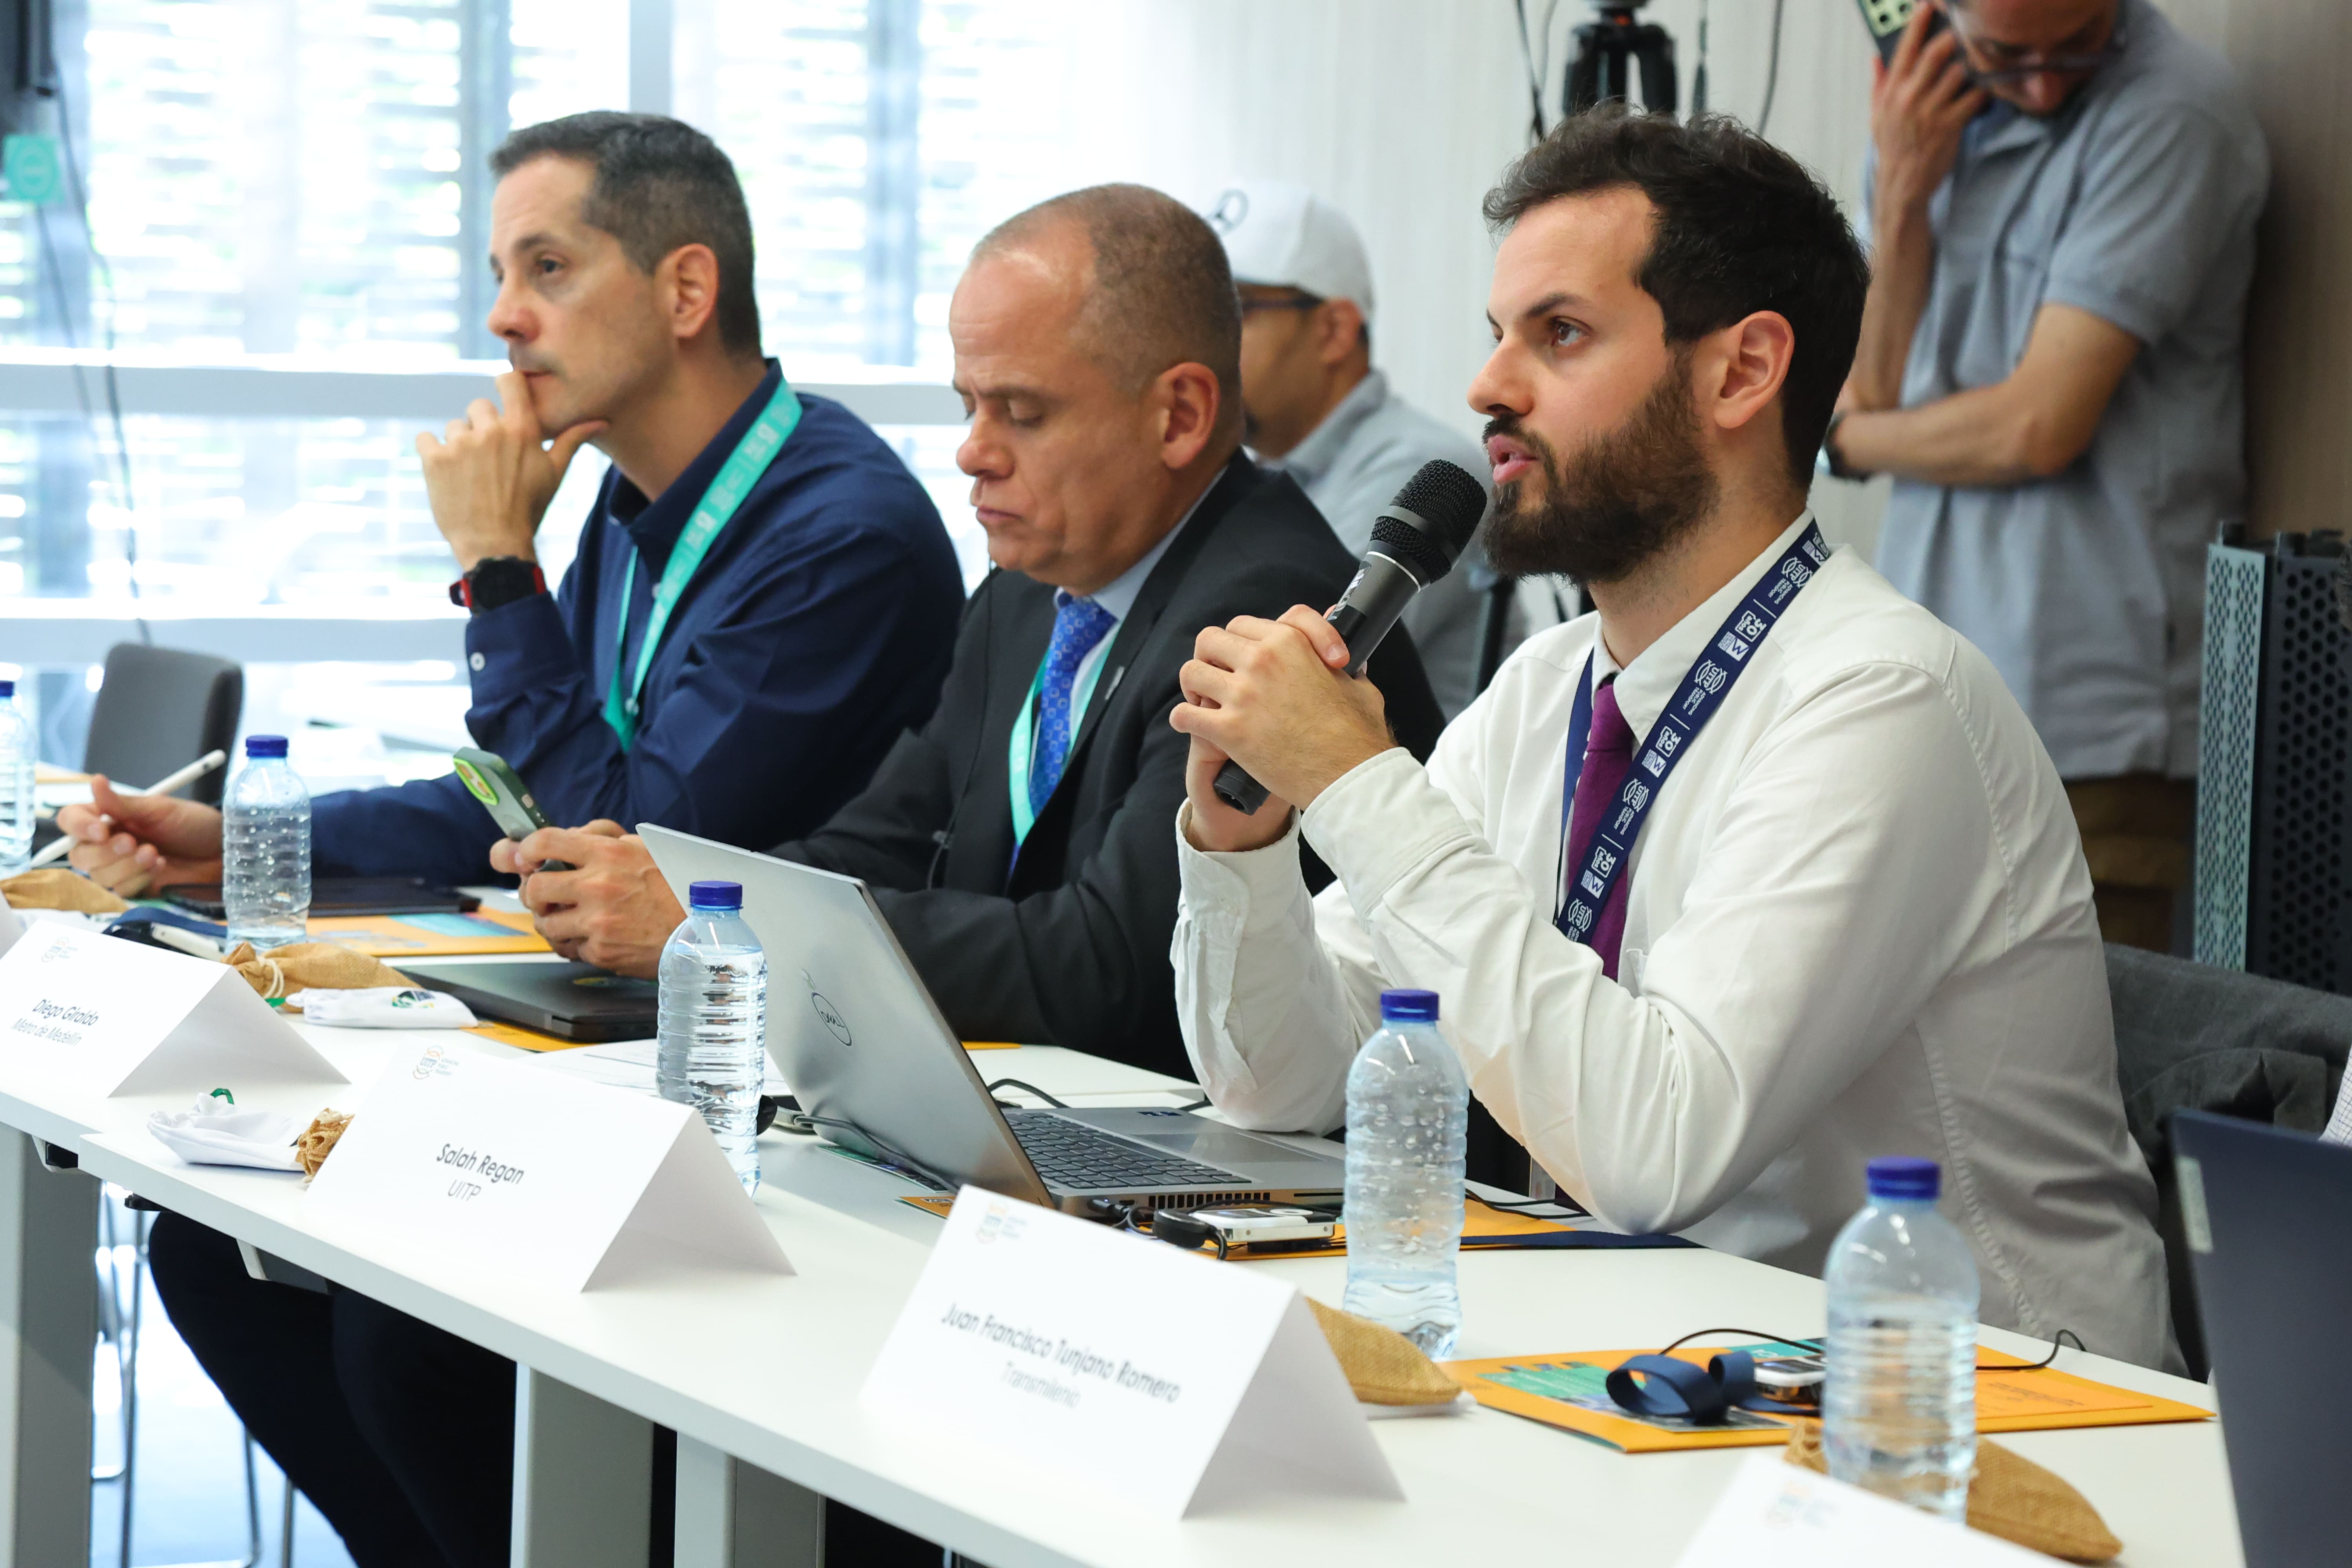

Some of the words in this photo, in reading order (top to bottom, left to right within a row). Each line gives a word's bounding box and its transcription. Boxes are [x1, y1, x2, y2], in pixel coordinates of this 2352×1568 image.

[1790, 564, 1807, 581] UITP
[1774, 583, 1793, 604] ADVANCING
[1777, 580, 1790, 594] PUBLIC
[1739, 615, 1753, 632] años
[1746, 618, 1767, 636] 30
[1703, 666, 1720, 688] UITP
[1682, 686, 1700, 710] TRANSPORT
[1688, 691, 1706, 716] ADVANCING
[1691, 688, 1703, 704] PUBLIC
[1659, 731, 1670, 748] años
[1664, 732, 1682, 751] 30
[1631, 785, 1645, 807] UITP
[1613, 806, 1629, 830] TRANSPORT
[1620, 810, 1635, 836] ADVANCING
[1622, 808, 1632, 823] PUBLIC
[1594, 851, 1604, 869] años
[1600, 852, 1617, 871] 30
[1575, 905, 1587, 927] UITP
[32, 999, 64, 1019] Diego
[62, 1006, 99, 1026] Giraldo
[11, 1018, 37, 1034] Metro
[34, 1024, 49, 1037] de
[436, 1143, 477, 1171] Salah
[476, 1155, 524, 1185] Regan
[448, 1179, 482, 1201] UITP
[941, 1302, 980, 1334] Juan
[980, 1314, 1053, 1357] Francisco
[1054, 1339, 1114, 1379] Tunjano
[1116, 1359, 1181, 1403] Romero
[1001, 1361, 1081, 1408] Transmilenio
